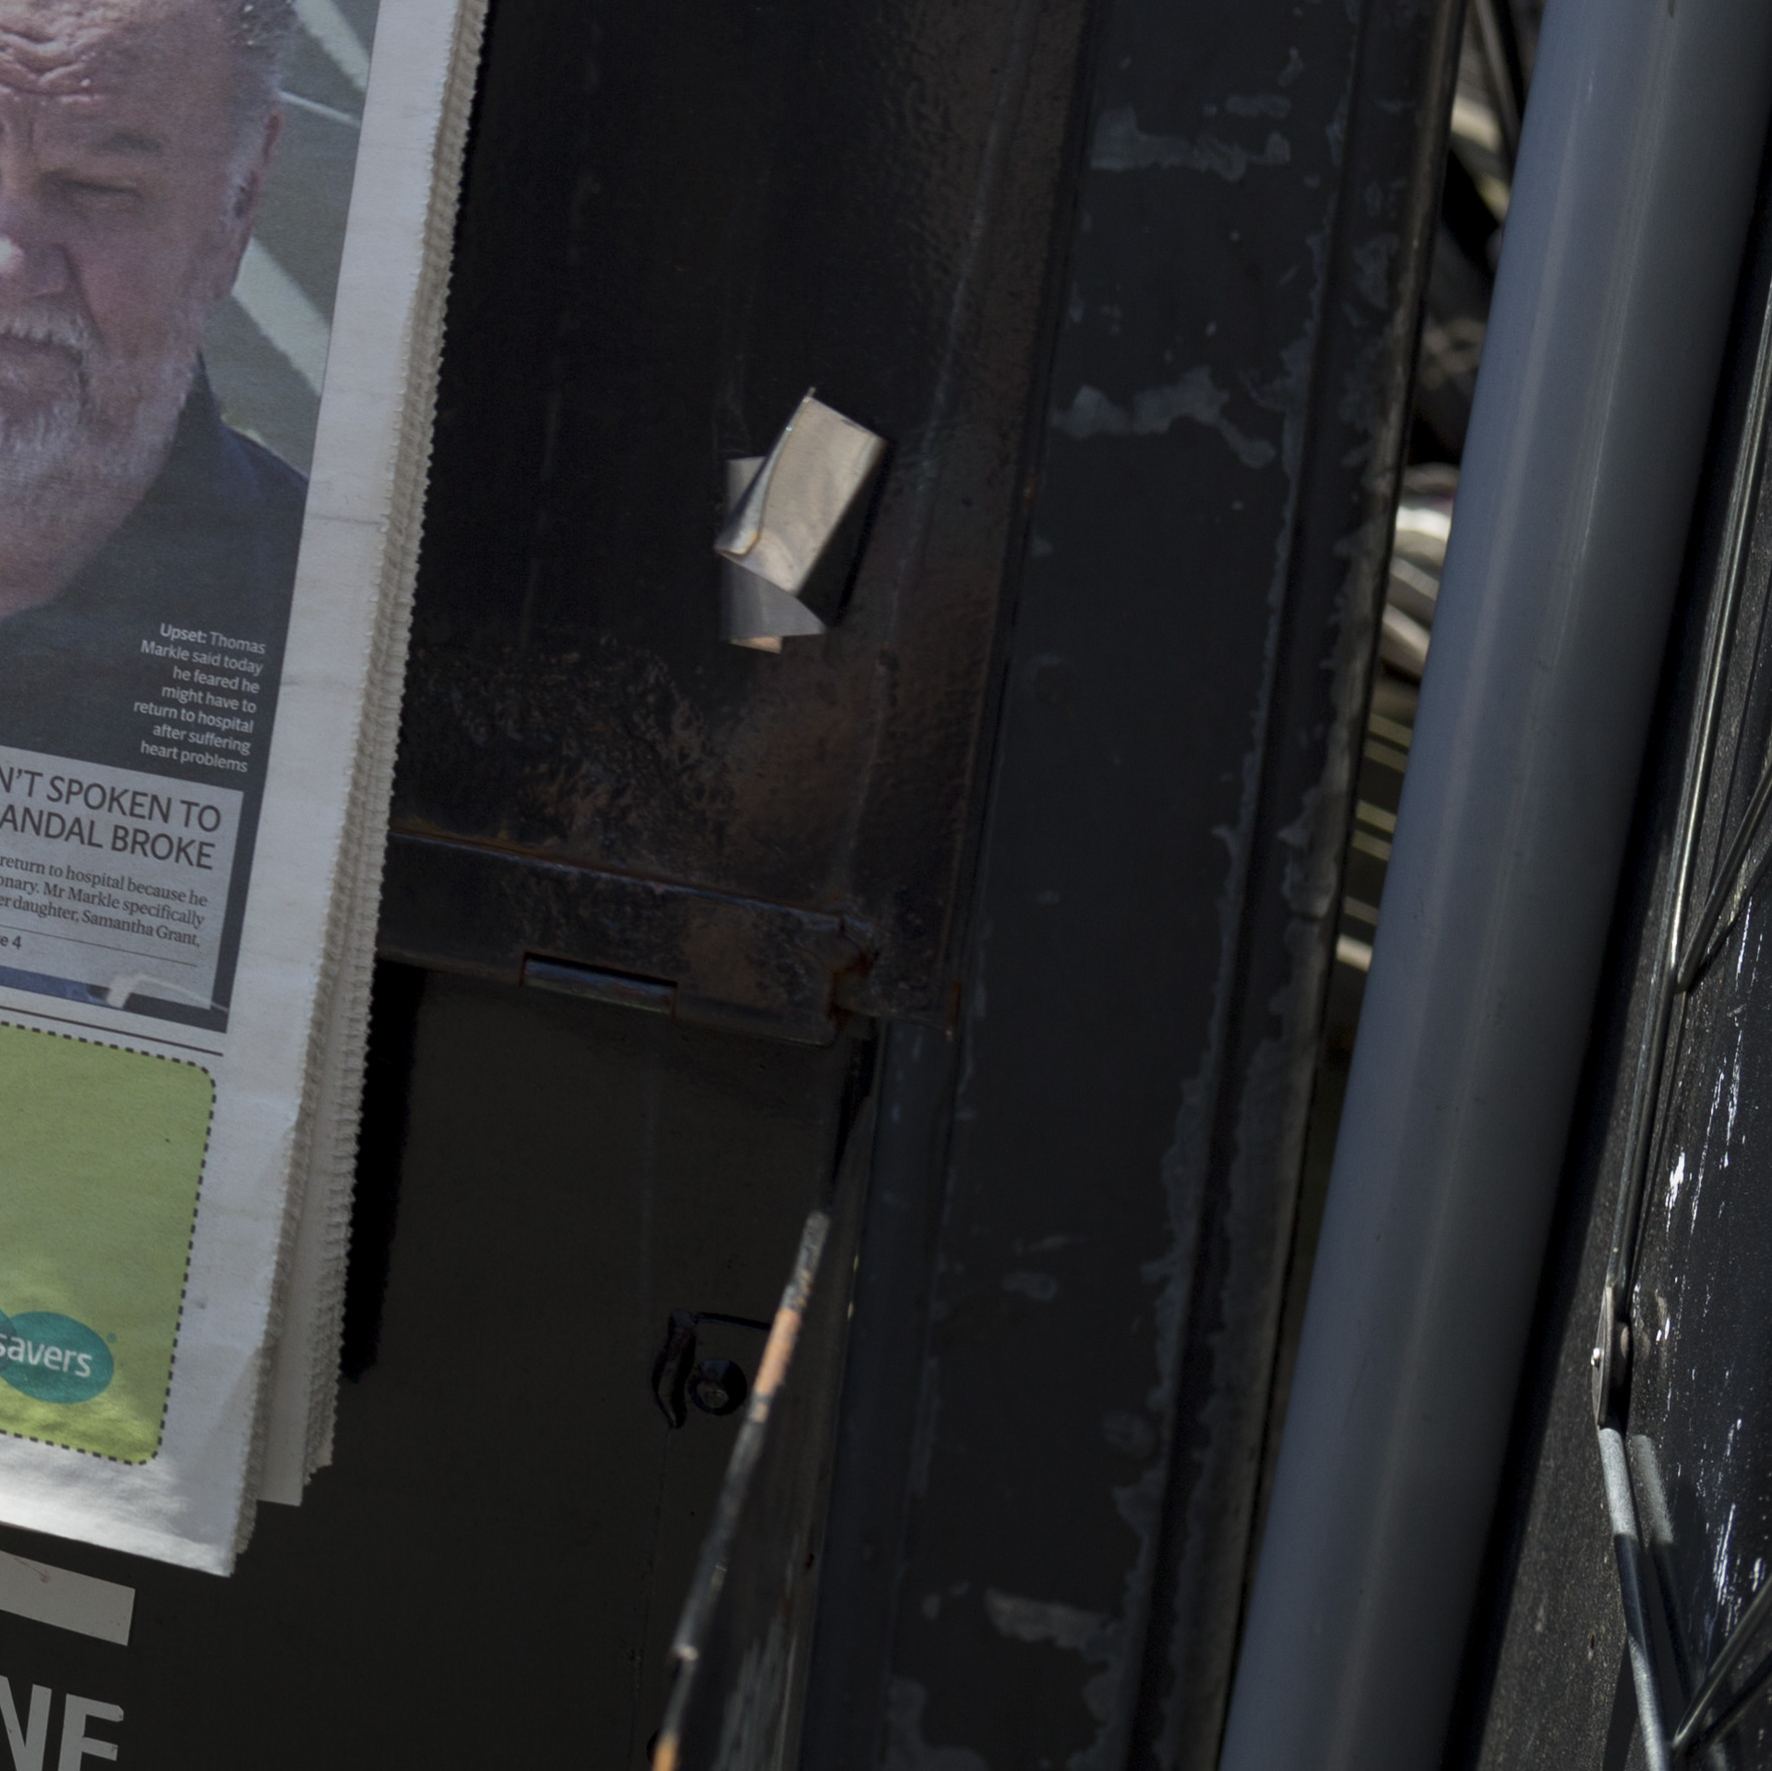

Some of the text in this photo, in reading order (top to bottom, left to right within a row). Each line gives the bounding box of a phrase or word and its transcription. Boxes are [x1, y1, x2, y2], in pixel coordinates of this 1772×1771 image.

[160, 623, 265, 654] Upset: Thomas
[140, 639, 263, 676] Markle said today
[173, 665, 260, 693] he feared he
[161, 686, 256, 713] might have to
[133, 702, 254, 733] return to hospital
[152, 723, 251, 755] after suffering
[140, 740, 247, 772] heart problems
[46, 775, 171, 823] SPOKEN
[180, 799, 221, 832] TO
[111, 824, 215, 870] BROKE
[12, 936, 21, 949] 4
